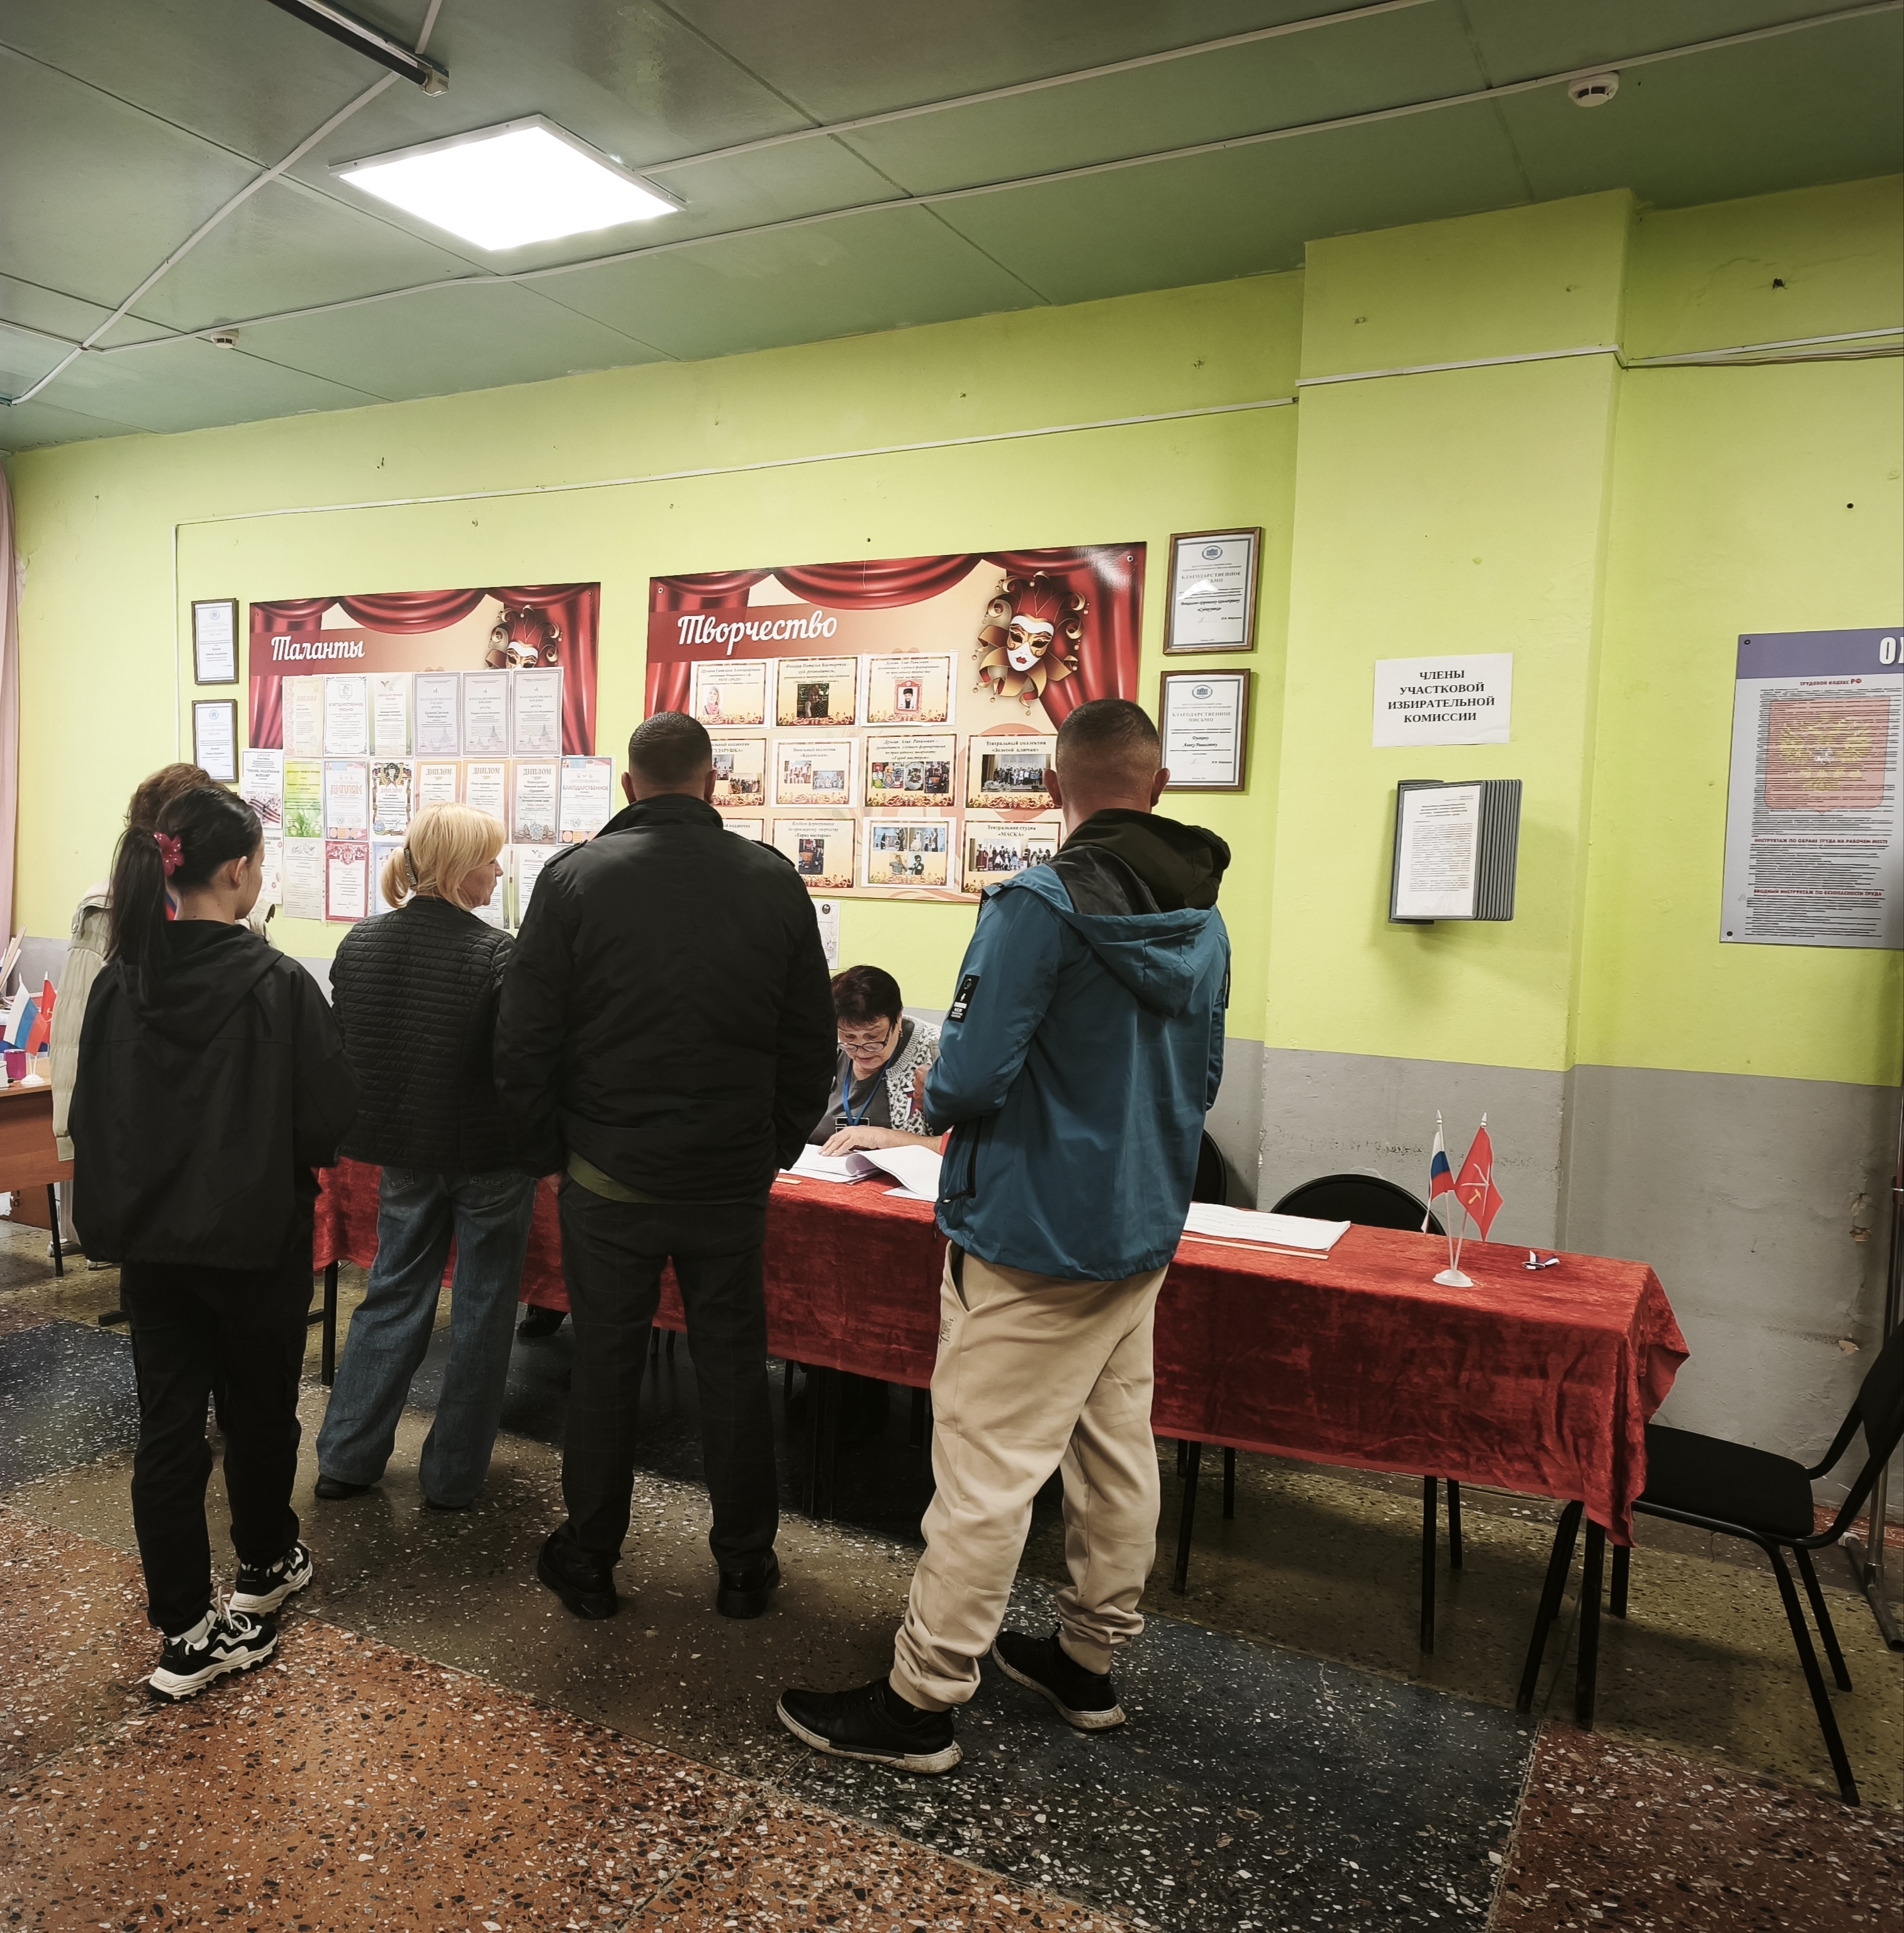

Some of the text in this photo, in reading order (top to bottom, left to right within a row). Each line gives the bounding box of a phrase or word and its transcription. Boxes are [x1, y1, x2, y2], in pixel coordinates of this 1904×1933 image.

[678, 610, 837, 655] Творчество
[271, 636, 365, 661] Таланты
[1420, 670, 1465, 680] ЧЛЕНЫ
[1399, 681, 1485, 695] УЧАСТКОВОЙ
[1387, 696, 1495, 710] ИЗБИРАТЕЛЬНОЙ
[1404, 712, 1477, 723] КОМИССИИ
[473, 767, 500, 775] ДИПЛОМ
